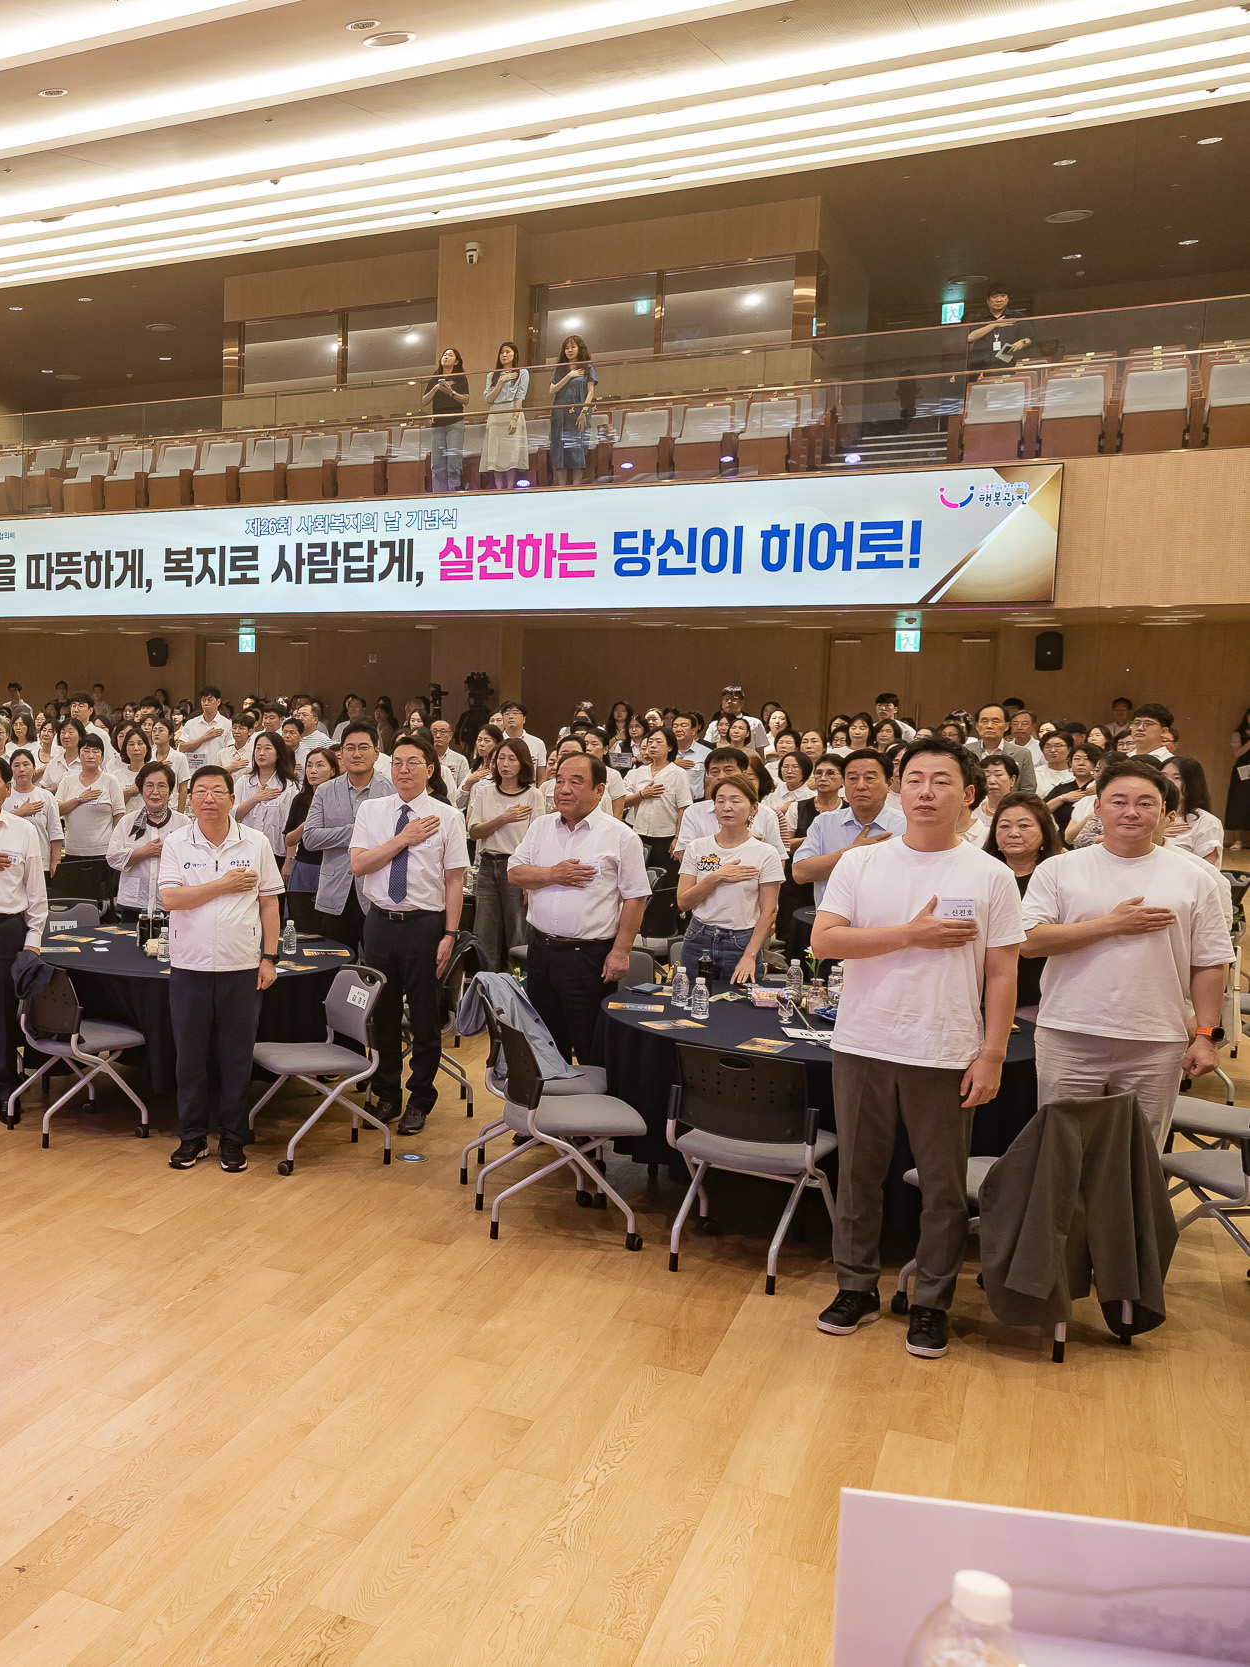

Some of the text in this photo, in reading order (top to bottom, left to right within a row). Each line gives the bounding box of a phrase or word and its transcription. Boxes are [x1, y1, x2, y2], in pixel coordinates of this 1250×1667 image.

[979, 492, 1028, 507] 행복광진
[245, 508, 458, 537] 제26회 사회복지의 날 기념식
[26, 548, 153, 594] 따뜻하게,
[163, 545, 260, 587] 복지로
[271, 538, 424, 588] 사람답게,
[438, 532, 597, 582] 실천하는
[613, 525, 744, 578] 당신이
[760, 520, 923, 573] 히어로!
[951, 909, 974, 917] 신진호
